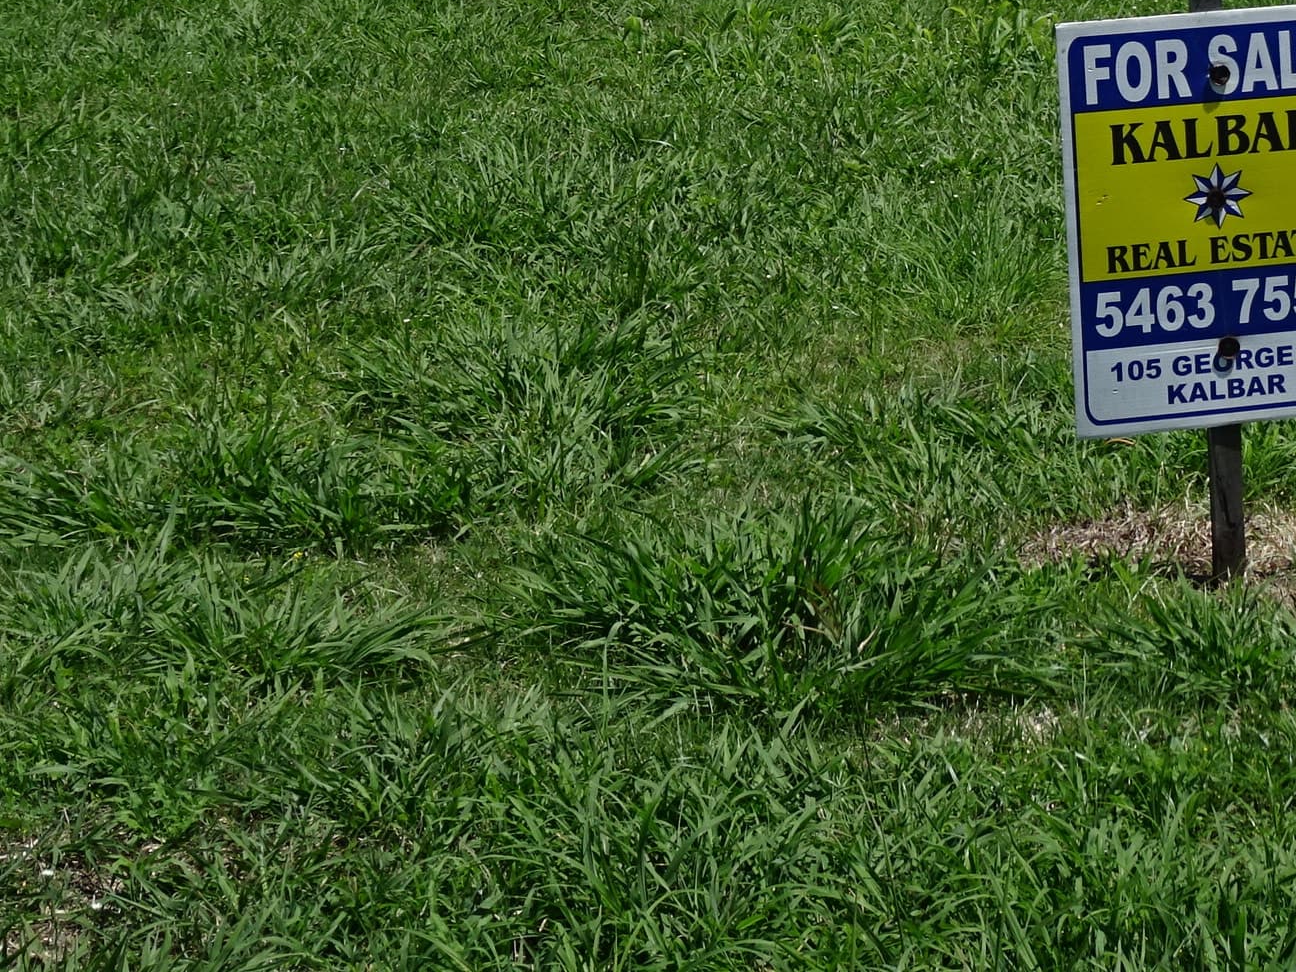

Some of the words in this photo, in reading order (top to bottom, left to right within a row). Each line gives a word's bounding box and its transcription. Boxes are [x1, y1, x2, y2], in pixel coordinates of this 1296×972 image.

[1083, 39, 1192, 105] FOR
[1106, 240, 1196, 273] REAL
[1095, 282, 1215, 337] 5463
[1111, 358, 1161, 382] 105
[1167, 373, 1286, 405] KALBAR
